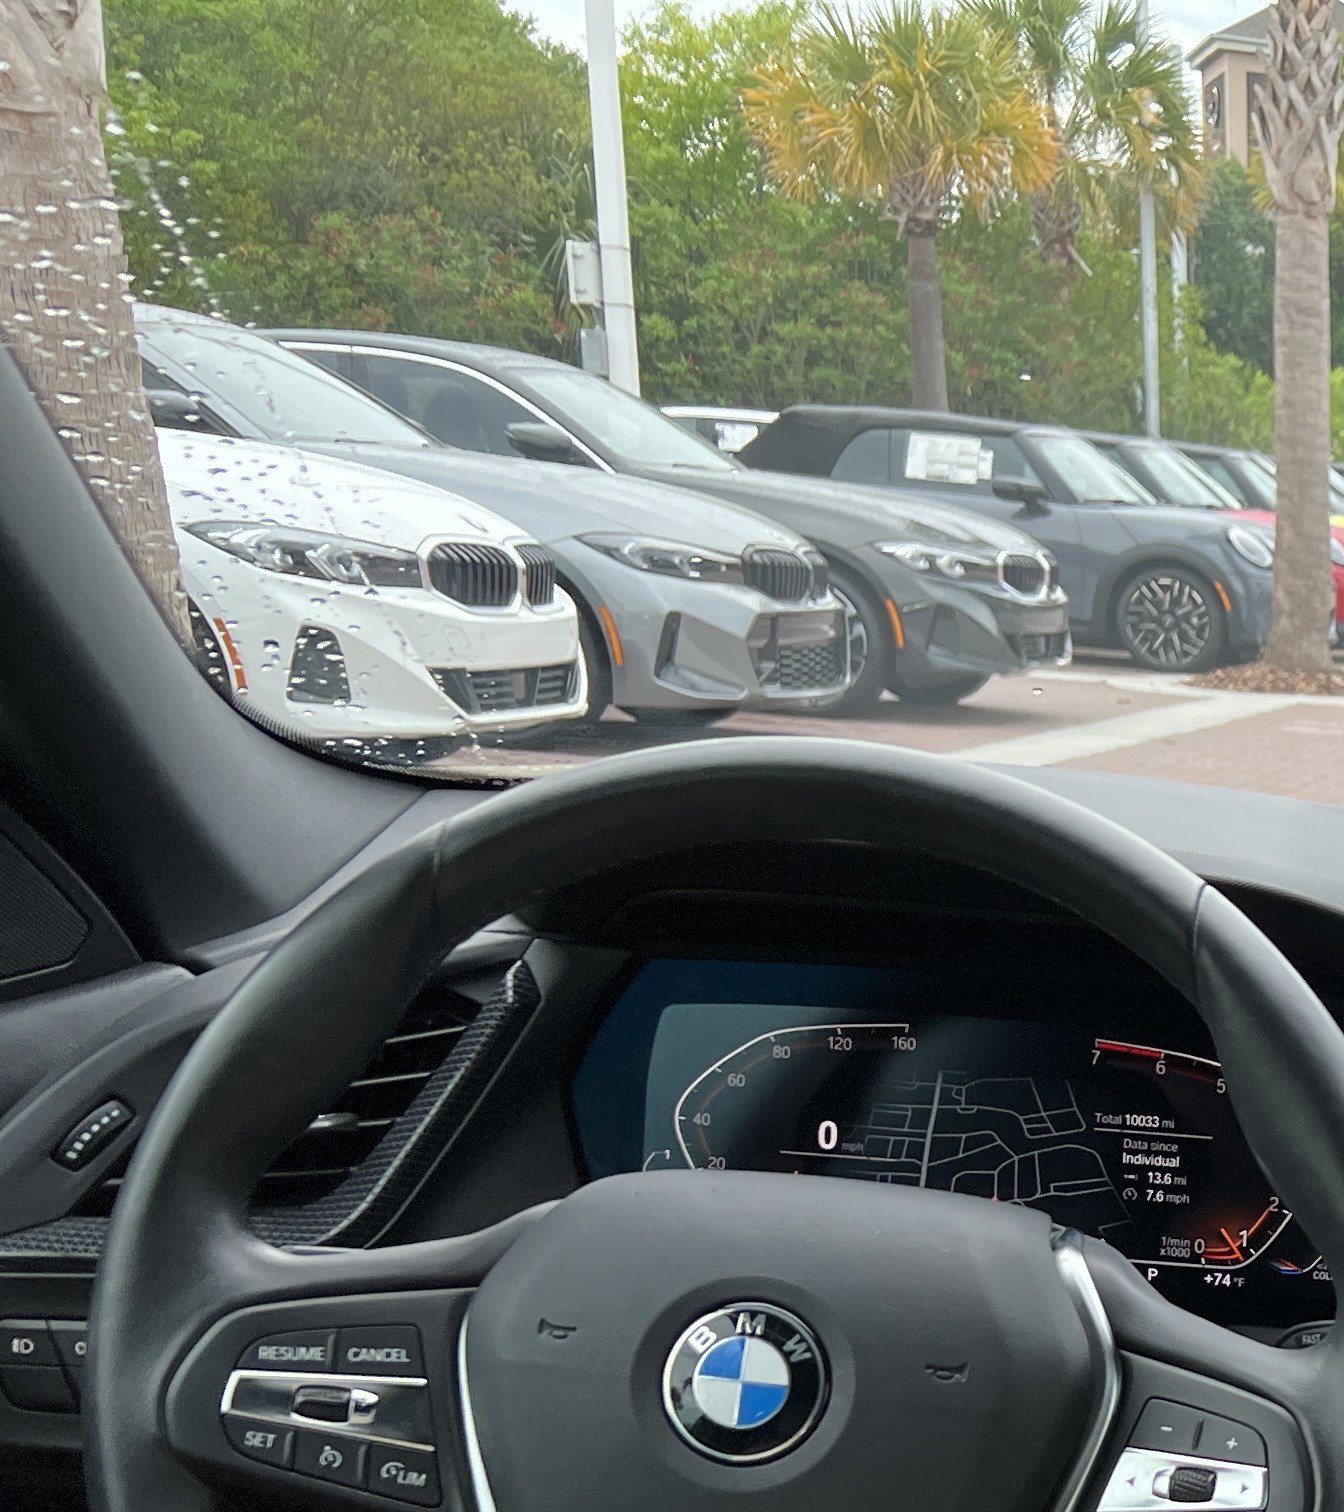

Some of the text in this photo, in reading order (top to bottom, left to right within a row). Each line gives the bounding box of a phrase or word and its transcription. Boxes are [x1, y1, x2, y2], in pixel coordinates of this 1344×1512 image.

[828, 1036, 852, 1051] 120
[892, 1036, 916, 1051] 160
[772, 1045, 791, 1059] 80
[1091, 1050, 1101, 1065] 7
[1155, 1061, 1166, 1075] 6
[727, 1073, 746, 1087] 60
[1216, 1079, 1226, 1094] 5
[692, 1113, 711, 1126] 40
[1094, 1112, 1175, 1129] Total 10033 mi
[817, 1119, 838, 1150] 0
[1123, 1138, 1178, 1152] Data since
[707, 1157, 726, 1170] 20
[1122, 1152, 1180, 1168] Individual
[1147, 1172, 1187, 1186] 13.6 mi
[1146, 1190, 1190, 1205] 7.6 mph
[1269, 1197, 1279, 1212] 2
[1160, 1236, 1191, 1248] 1/min
[1194, 1239, 1205, 1253] 0
[1238, 1230, 1248, 1247] 1
[1159, 1246, 1191, 1258] x1000
[1147, 1268, 1158, 1280] P
[1203, 1272, 1231, 1287] +74
[687, 1312, 812, 1363] BMW
[258, 1346, 325, 1361] RESUME
[347, 1347, 410, 1363] CANCEL
[244, 1431, 277, 1448] SET
